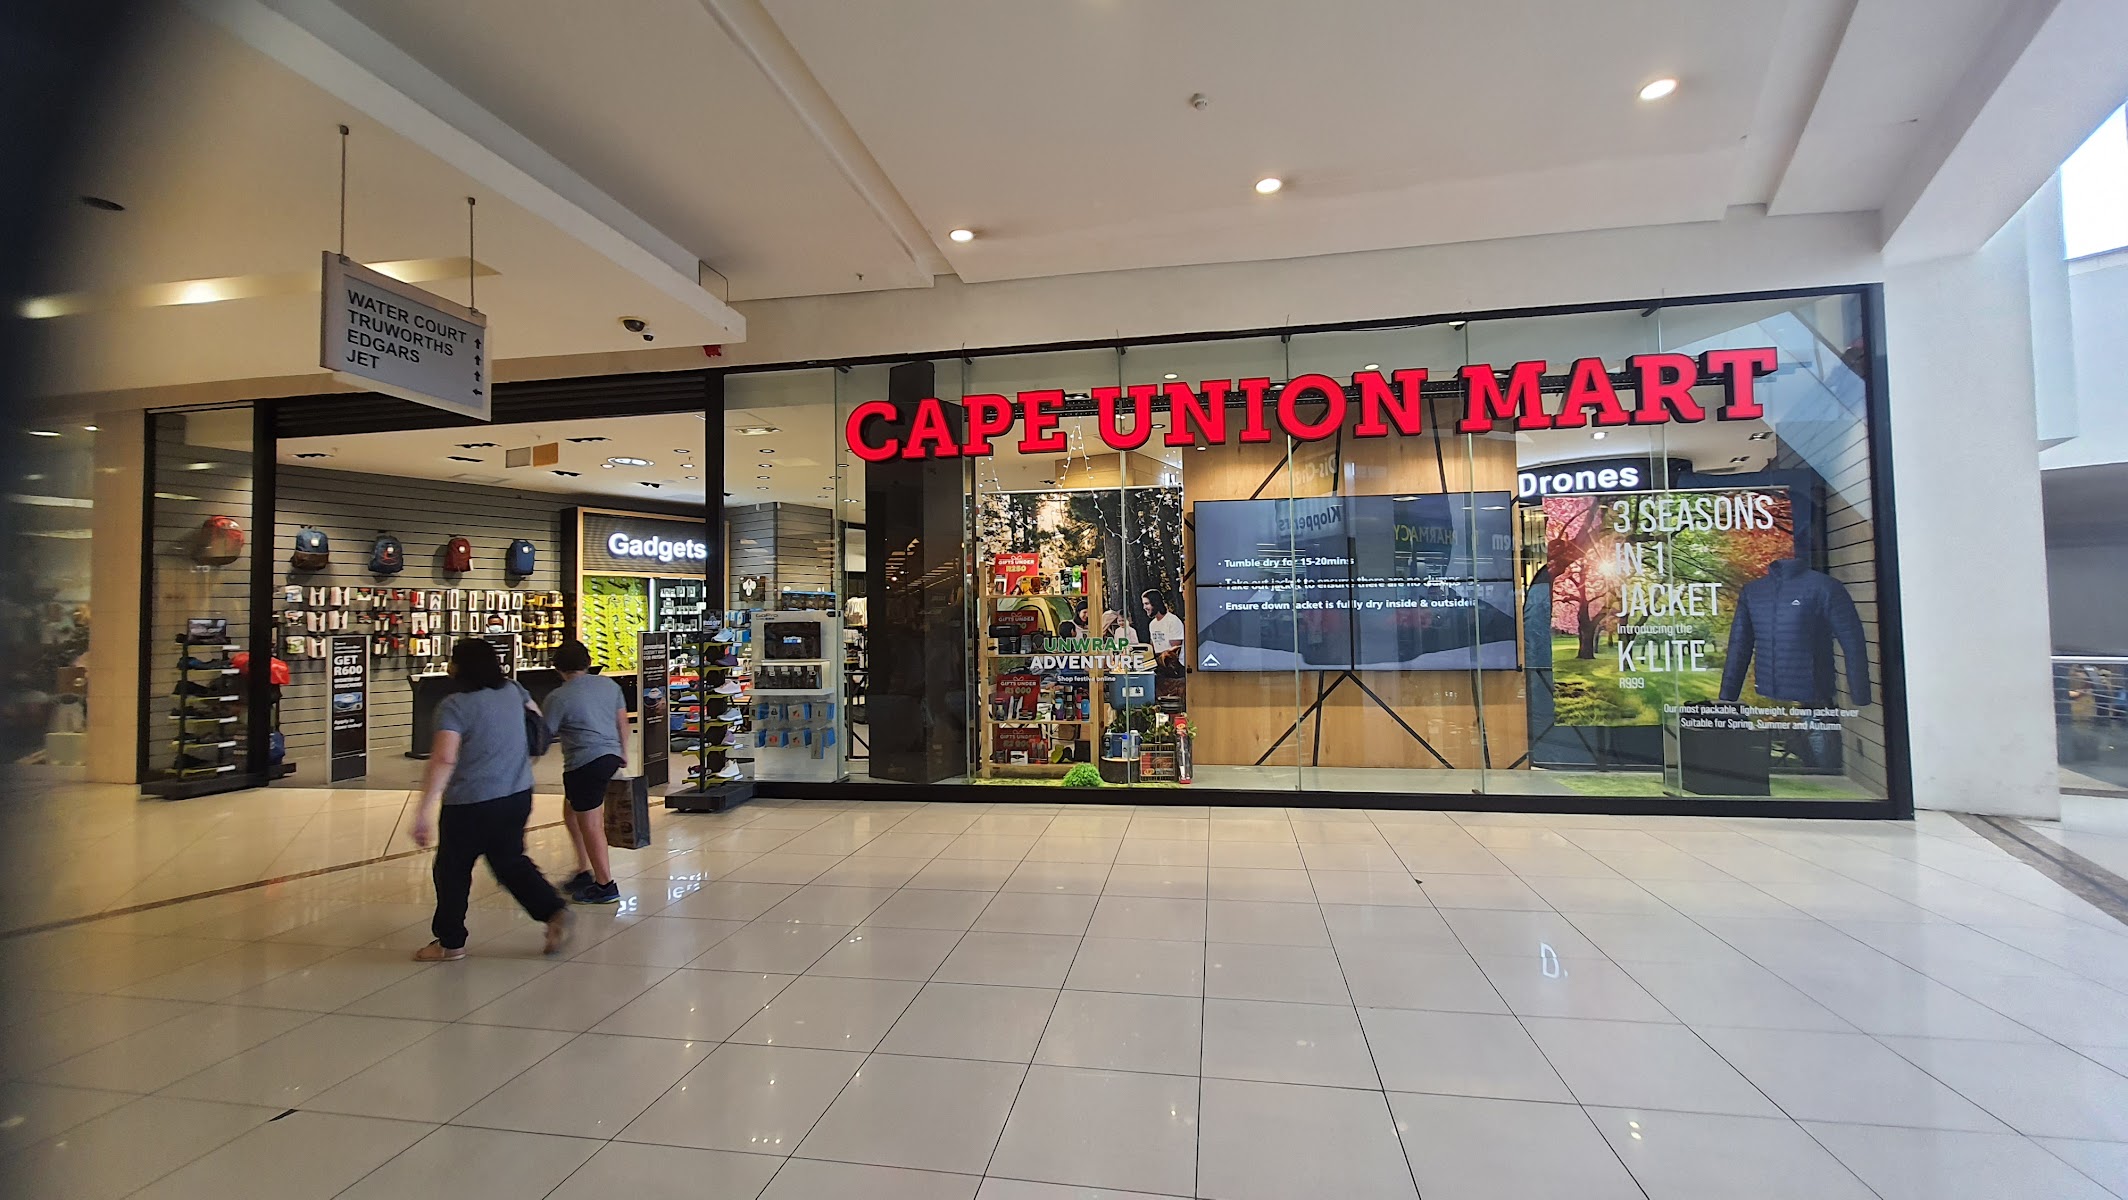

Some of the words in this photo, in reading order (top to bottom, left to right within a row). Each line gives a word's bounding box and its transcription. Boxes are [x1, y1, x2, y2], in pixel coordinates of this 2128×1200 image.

[348, 289, 409, 324] WATER
[415, 315, 467, 344] COURT
[348, 309, 454, 356] TRUWORTHS
[348, 329, 420, 363] EDGARS
[346, 350, 380, 369] JET
[845, 388, 1068, 464] CAPE
[1091, 367, 1429, 452] UNION
[1457, 346, 1778, 435] MART
[1518, 466, 1640, 498] Drones
[1613, 500, 1630, 533] 3
[1640, 494, 1774, 533] SEASONS
[608, 532, 708, 563] Gadgets
[1225, 558, 1260, 567] Tumble
[1263, 558, 1279, 568] dry
[1300, 557, 1355, 566] 15-20mins
[1615, 542, 1644, 576] IN
[1652, 541, 1665, 575] 1
[1226, 602, 1259, 611] Ensure
[1261, 601, 1290, 610] down
[1325, 600, 1334, 609] is
[1366, 599, 1383, 610] dry
[1386, 598, 1417, 608] inside
[1420, 599, 1429, 608] &
[1616, 582, 1722, 618] JACKET
[1617, 623, 1673, 637] Introducing
[1675, 623, 1693, 634] the
[1043, 637, 1130, 653] UNWRAP
[334, 655, 359, 666] GET
[1030, 655, 1145, 670] ADVENTURE
[1618, 640, 1707, 672] K-LITE
[334, 664, 363, 676] R600
[1057, 675, 1074, 683] Shop
[1619, 677, 1645, 689] R999
[1664, 704, 1678, 714] Our
[1679, 705, 1700, 714] most
[1700, 704, 1739, 716] packable,
[1740, 705, 1788, 719] lightweight,
[1790, 706, 1812, 717] down
[1813, 707, 1839, 719] jacket
[1841, 709, 1859, 718] ever
[1680, 718, 1713, 729] Suitable
[1715, 718, 1726, 729] for
[1727, 719, 1755, 731] Spring,
[1757, 719, 1790, 731] Summer
[1792, 720, 1808, 731] and
[1809, 720, 1842, 732] Autumn
